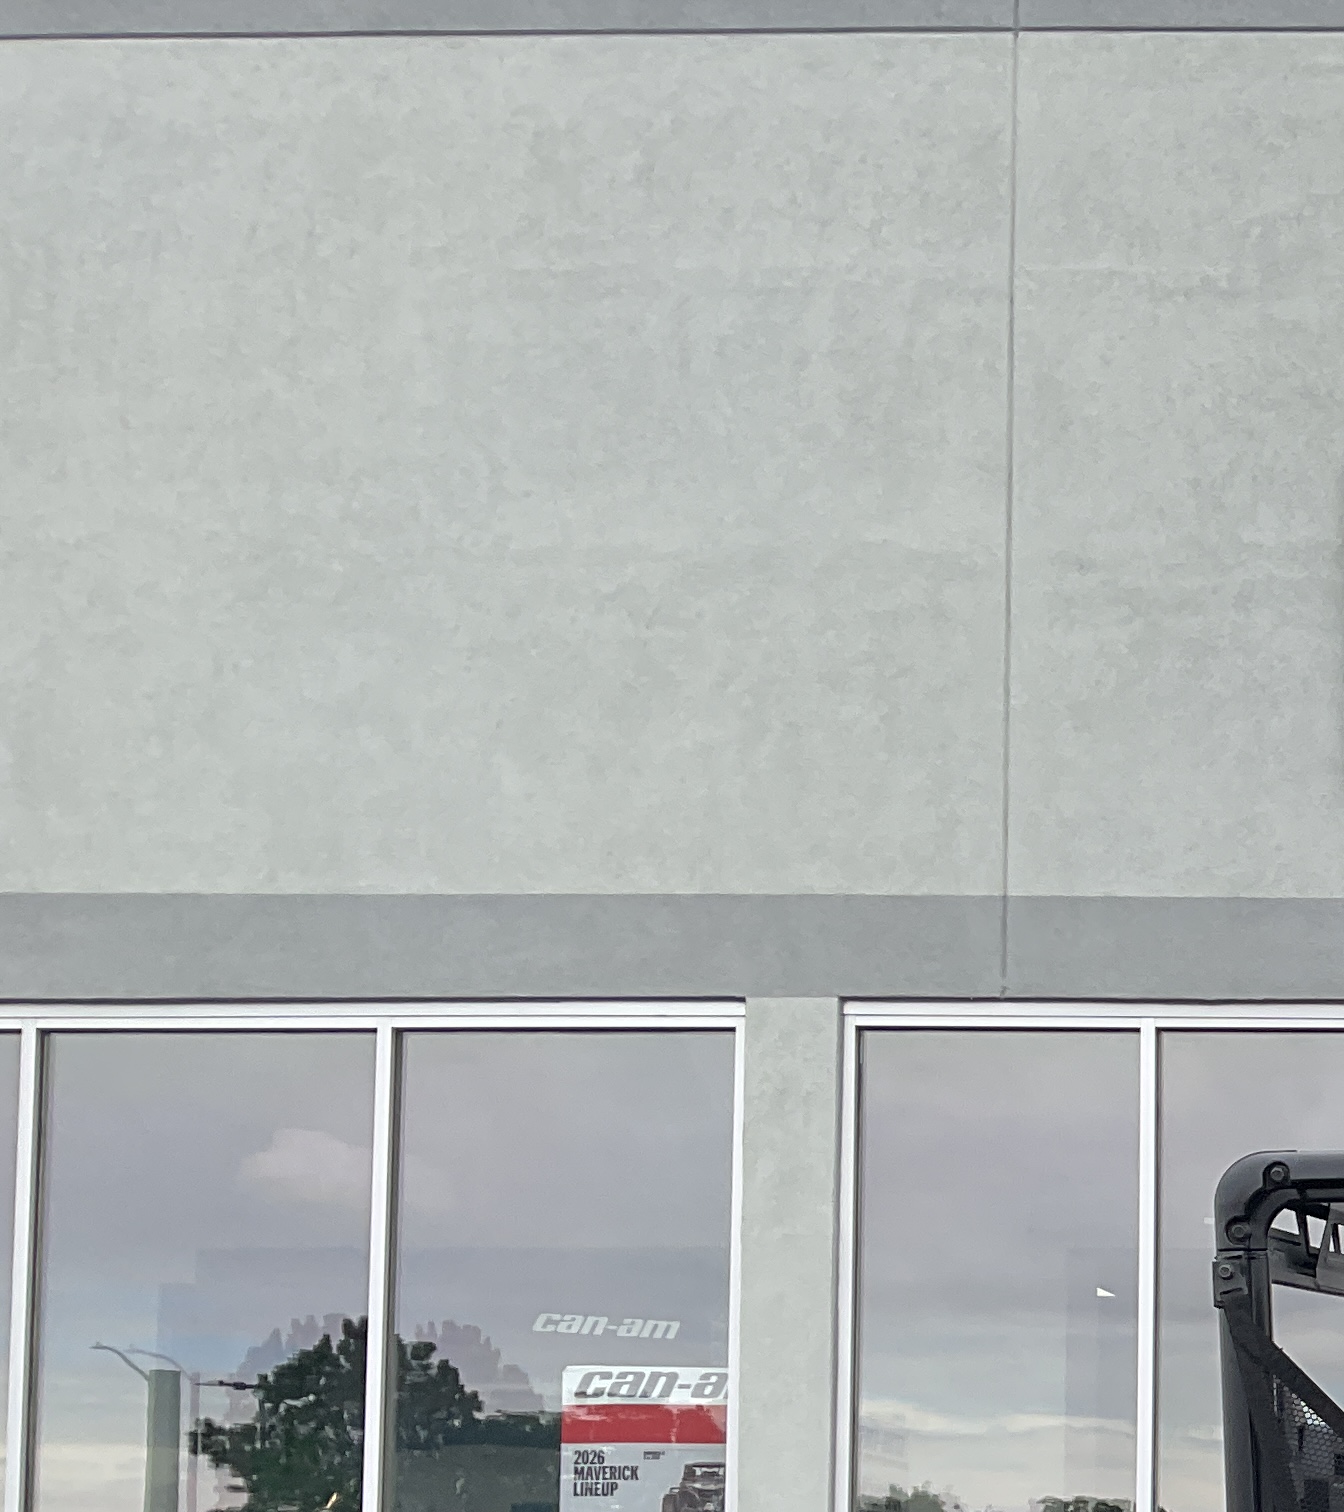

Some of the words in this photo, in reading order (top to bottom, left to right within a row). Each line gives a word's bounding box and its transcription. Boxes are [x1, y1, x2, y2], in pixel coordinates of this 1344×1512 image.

[532, 1313, 681, 1340] can-am
[573, 1370, 727, 1399] can-a
[573, 1450, 605, 1465] 2026
[573, 1465, 640, 1481] MAVERICK
[573, 1481, 619, 1497] LINEUP
